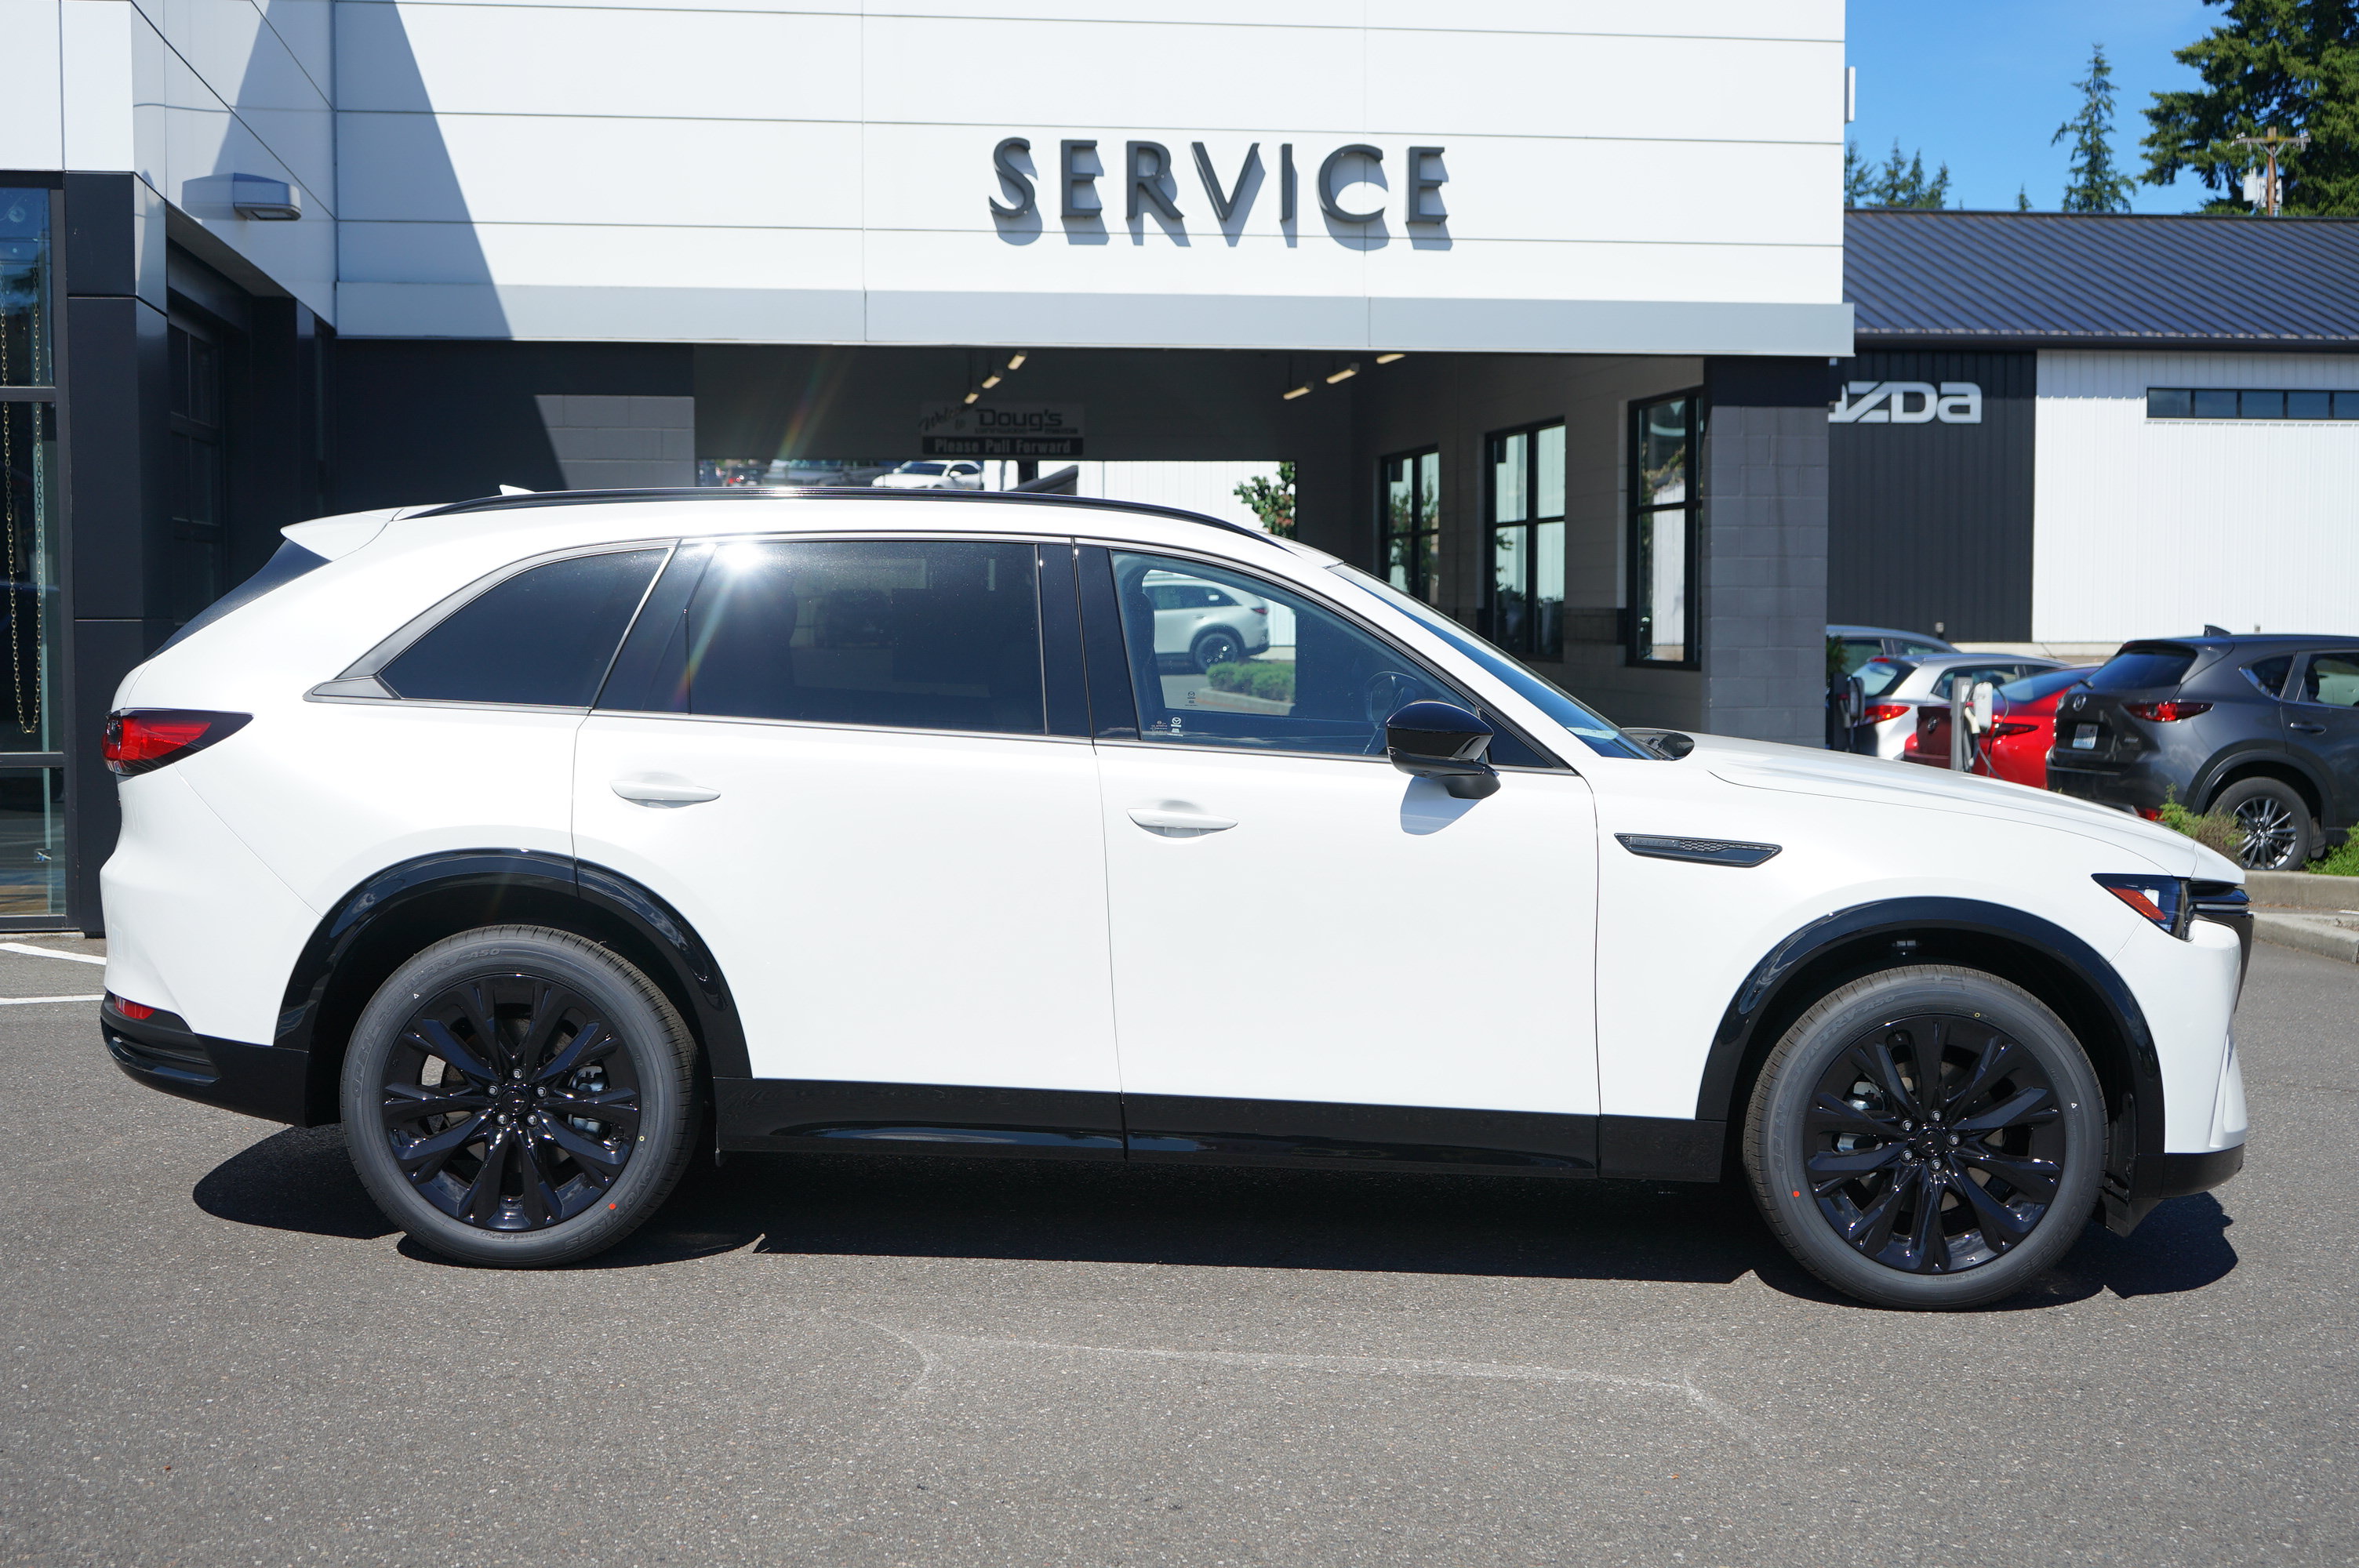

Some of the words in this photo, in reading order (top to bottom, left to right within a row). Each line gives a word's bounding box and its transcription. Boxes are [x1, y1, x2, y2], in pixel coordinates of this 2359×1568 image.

[989, 136, 1448, 224] SERVICE
[974, 408, 1063, 431] Doug's
[934, 438, 980, 453] Please
[985, 438, 1011, 453] Pull
[1015, 438, 1071, 453] Forward
